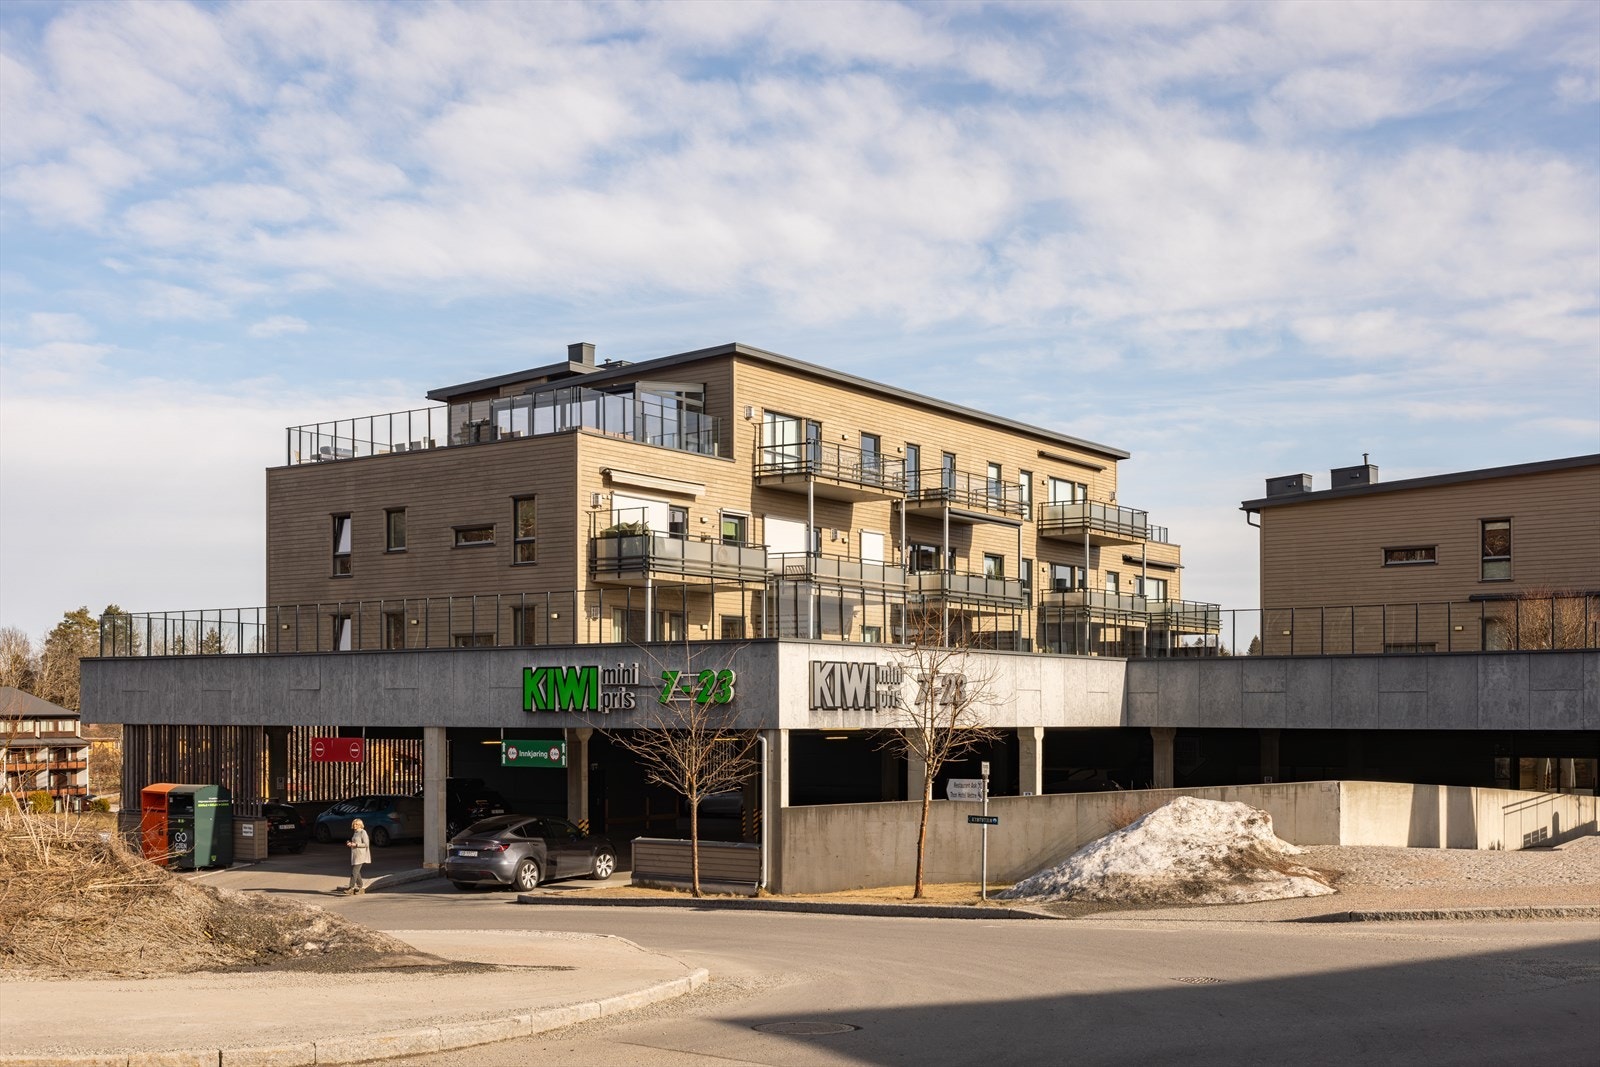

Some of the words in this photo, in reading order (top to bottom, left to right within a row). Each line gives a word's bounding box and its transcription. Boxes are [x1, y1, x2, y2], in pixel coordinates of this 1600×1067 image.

[602, 662, 639, 684] mini
[809, 661, 877, 711] KIWI
[877, 661, 904, 685] mini
[523, 665, 600, 712] KIWI
[602, 687, 636, 713] pris
[658, 669, 737, 705] 7-23
[877, 686, 902, 712] pris
[519, 750, 548, 759] Innkjøring
[175, 832, 187, 842] GO
